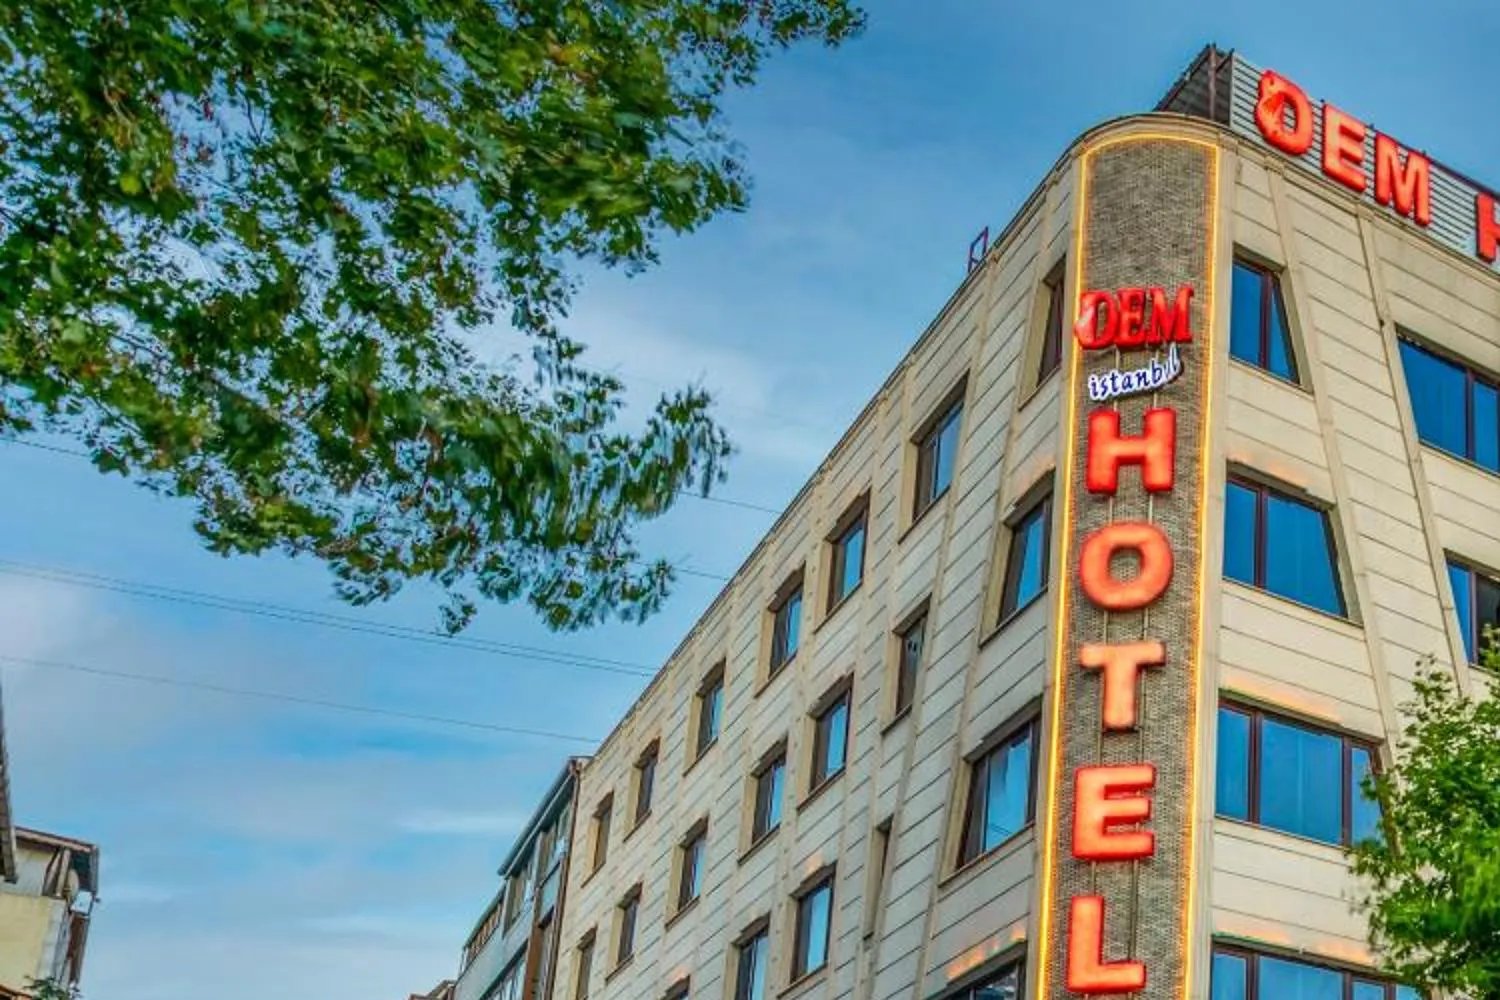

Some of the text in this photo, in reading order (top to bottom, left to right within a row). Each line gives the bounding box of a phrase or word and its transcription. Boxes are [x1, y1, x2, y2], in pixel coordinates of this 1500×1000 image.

[1254, 69, 1434, 227] OEM
[1075, 283, 1194, 350] OEM
[1065, 406, 1177, 994] HOTEL
